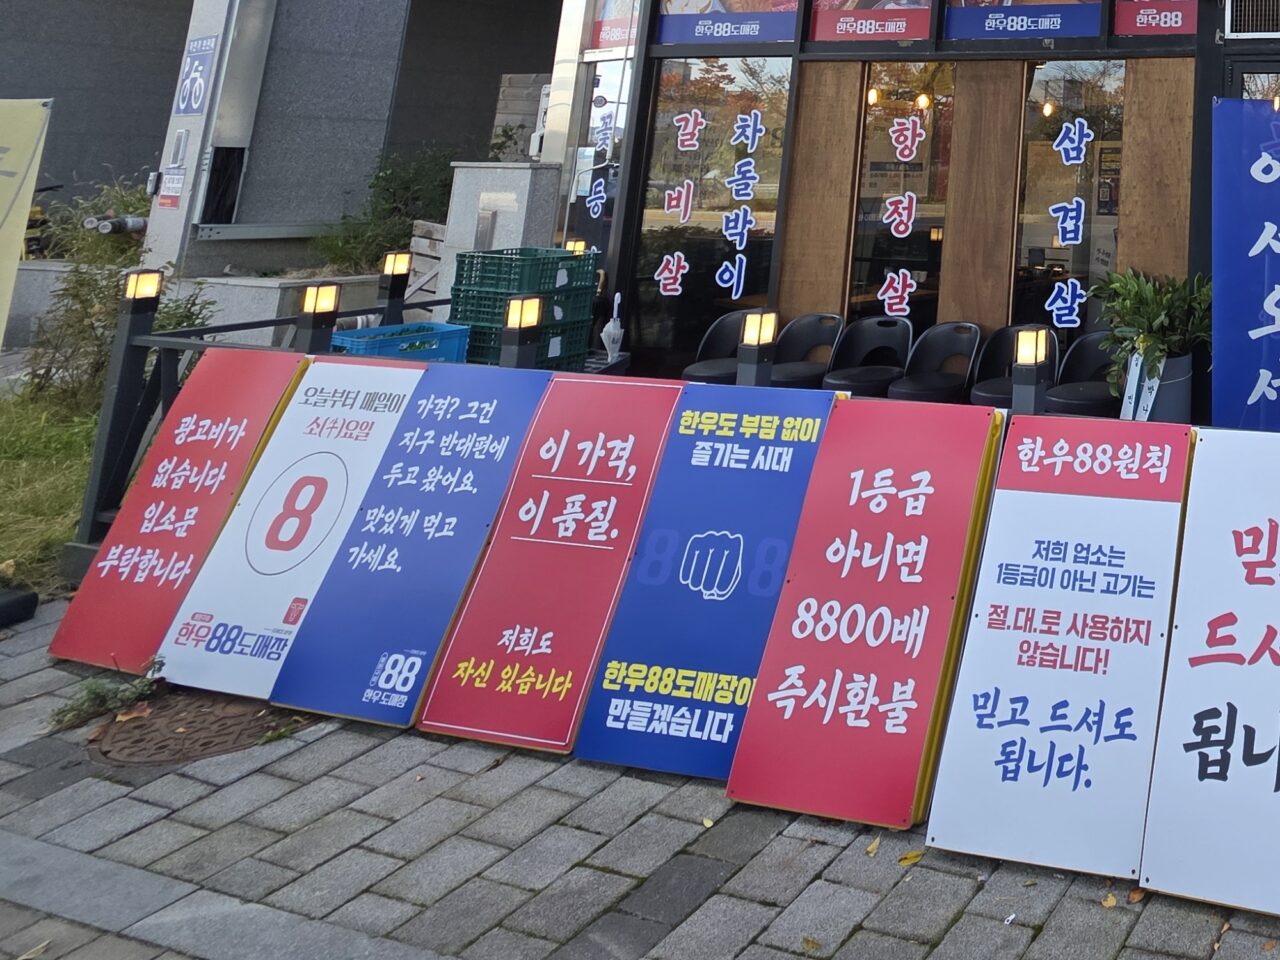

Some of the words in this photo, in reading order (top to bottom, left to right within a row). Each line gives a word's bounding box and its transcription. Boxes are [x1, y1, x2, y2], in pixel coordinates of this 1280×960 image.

[694, 22, 760, 37] 한우88도매장
[836, 19, 907, 34] 한우88도매장
[985, 15, 1061, 31] 한우88도매장
[655, 108, 706, 296] 갈비살
[715, 109, 766, 301] 차돌박이
[877, 115, 926, 317] 항정살
[1045, 117, 1094, 328] 삼겹살
[298, 386, 361, 410] 오늘부터
[359, 391, 407, 414] 매일이
[417, 395, 459, 420] 가격?
[458, 399, 497, 424] 그건
[173, 413, 248, 446] 광고비가
[398, 429, 435, 457] 지구
[440, 433, 510, 462] 반대편에
[677, 408, 737, 440] 한우도
[738, 411, 780, 441] 부담
[783, 416, 822, 443] 없이
[538, 429, 570, 474] 이
[576, 432, 637, 482] 가격,
[690, 444, 750, 470] 즐기는
[752, 445, 792, 474] 시대
[1015, 434, 1173, 485] 한우88원칙
[151, 457, 227, 495] 없습니다
[382, 462, 416, 489] 두고
[422, 466, 479, 495] 왔어요.
[848, 467, 936, 517] 1등급
[139, 501, 199, 538] 입소문
[264, 475, 329, 553] 8
[359, 504, 417, 537] 맛있게
[423, 511, 457, 541] 먹고
[517, 490, 549, 536] 이
[552, 495, 619, 542] 품질.
[97, 545, 196, 590] 부탁합니다
[347, 542, 403, 574] 가세요.
[825, 527, 930, 585] 아니면
[1031, 539, 1069, 568] 저희
[1073, 541, 1126, 569] 업소는
[996, 562, 1056, 590] 1등급이
[1059, 569, 1096, 595] 아닌
[1100, 572, 1156, 600] 고기는
[173, 622, 290, 662] 한우88도매장
[496, 625, 555, 656] 저희도
[790, 595, 931, 660] 8800배
[986, 603, 1061, 637] 절.대.로
[1065, 608, 1152, 647] 사용하지
[378, 653, 422, 693] 88
[1016, 639, 1111, 677] 않습니다!
[451, 656, 493, 689] 자신
[497, 661, 574, 702] 있습니다
[767, 663, 919, 736] 즉시환불
[971, 686, 1030, 731] 믿고
[1039, 698, 1137, 746] 드셔도
[606, 699, 735, 745] 만들겠습니다
[994, 736, 1092, 792] 됩니다.
